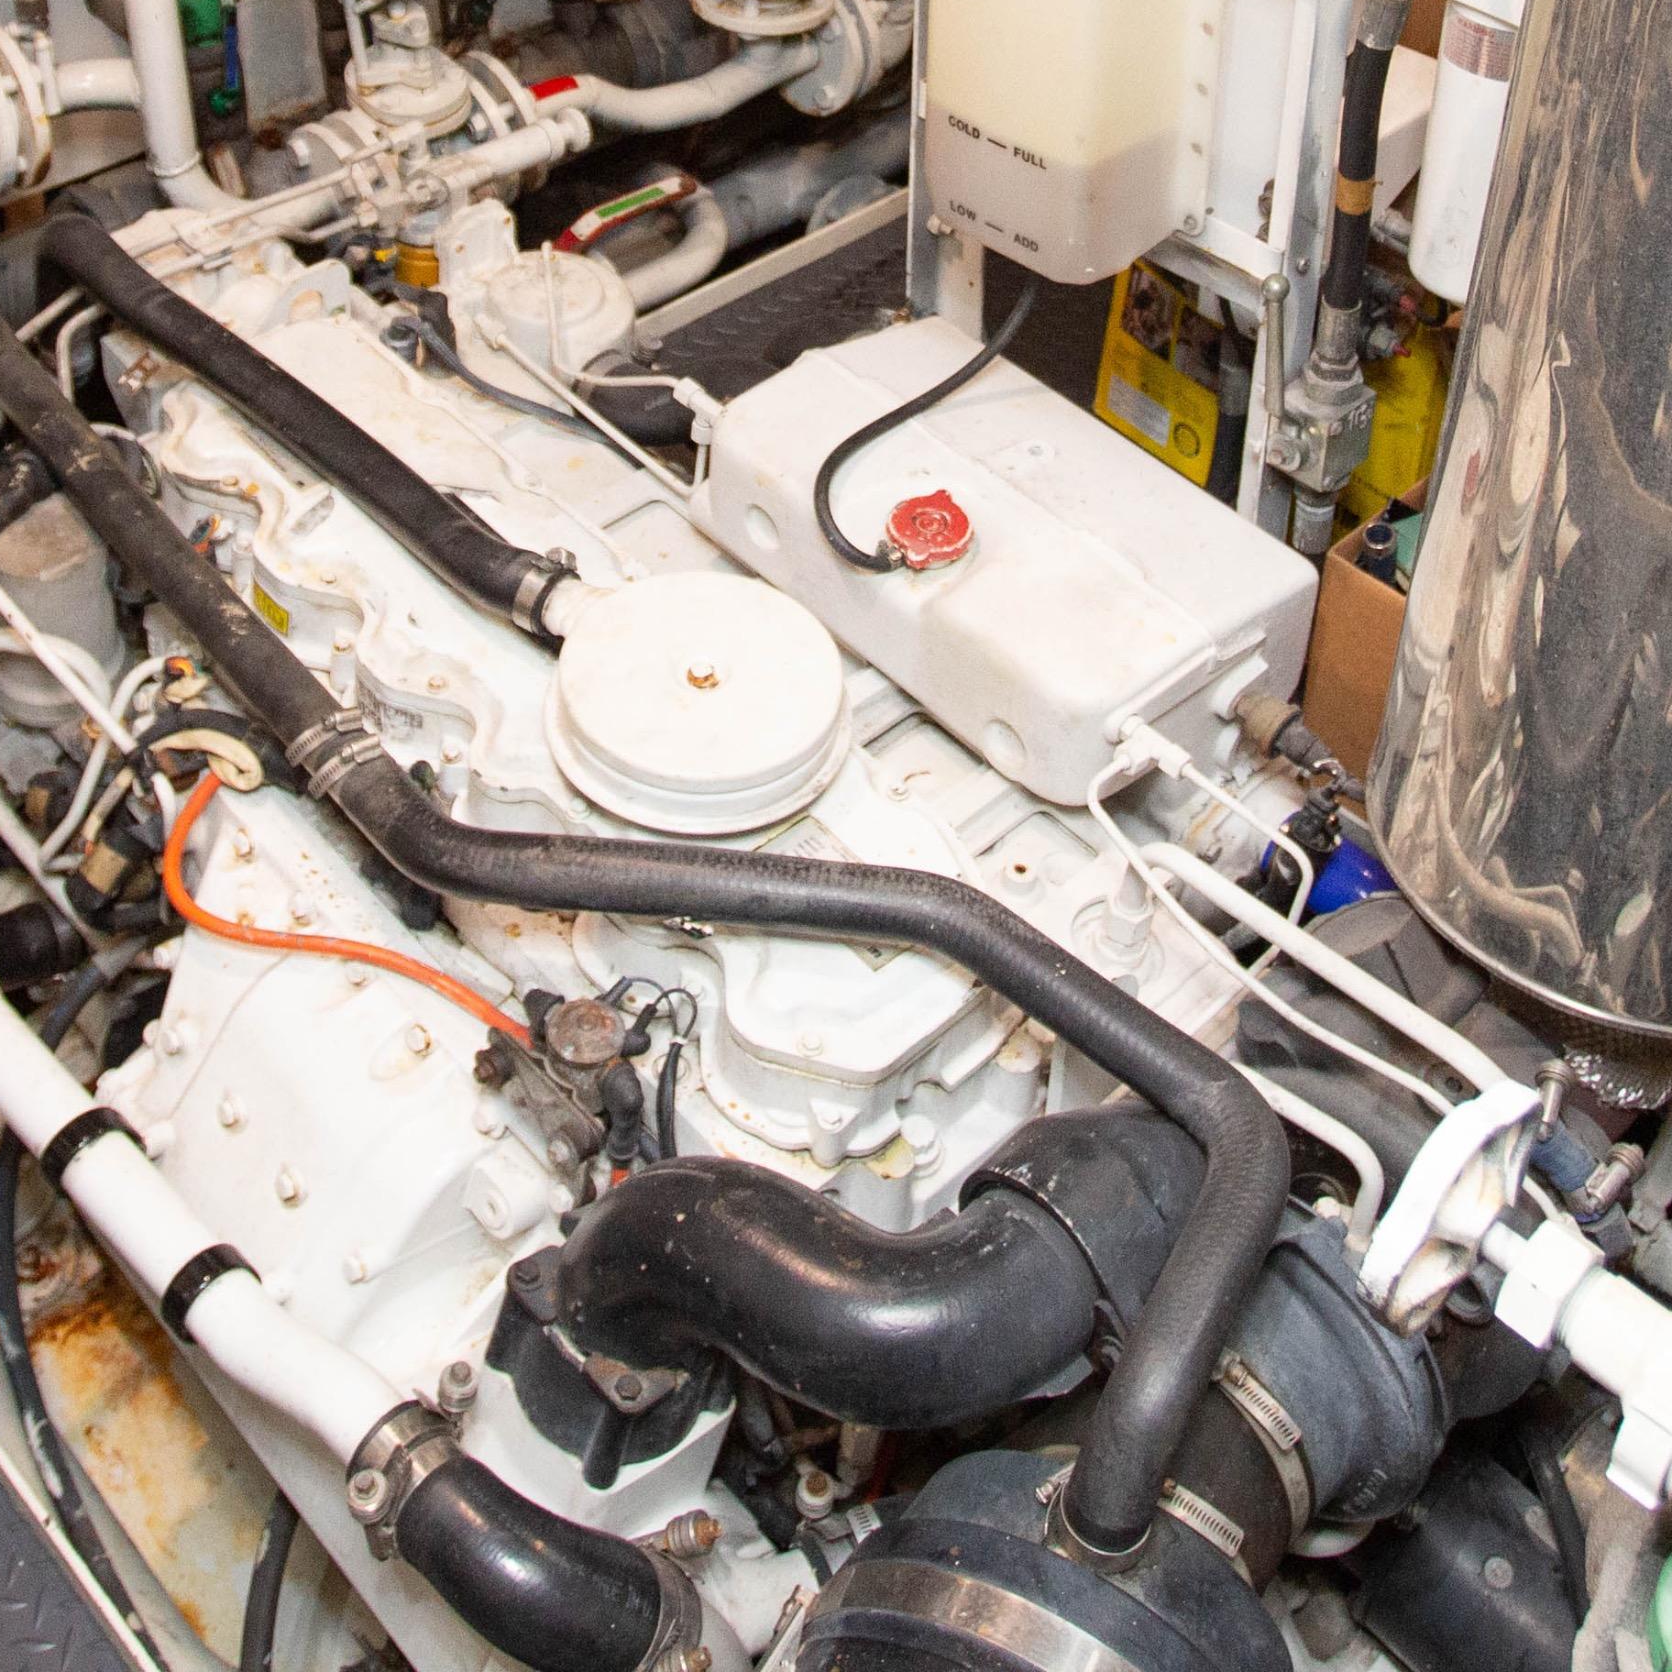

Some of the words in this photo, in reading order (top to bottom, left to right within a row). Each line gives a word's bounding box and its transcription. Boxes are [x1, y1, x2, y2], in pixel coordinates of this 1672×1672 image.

[947, 114, 981, 140] COLD
[1012, 146, 1048, 170] FULL
[949, 200, 977, 222] LOW
[1013, 233, 1040, 253] ADD
